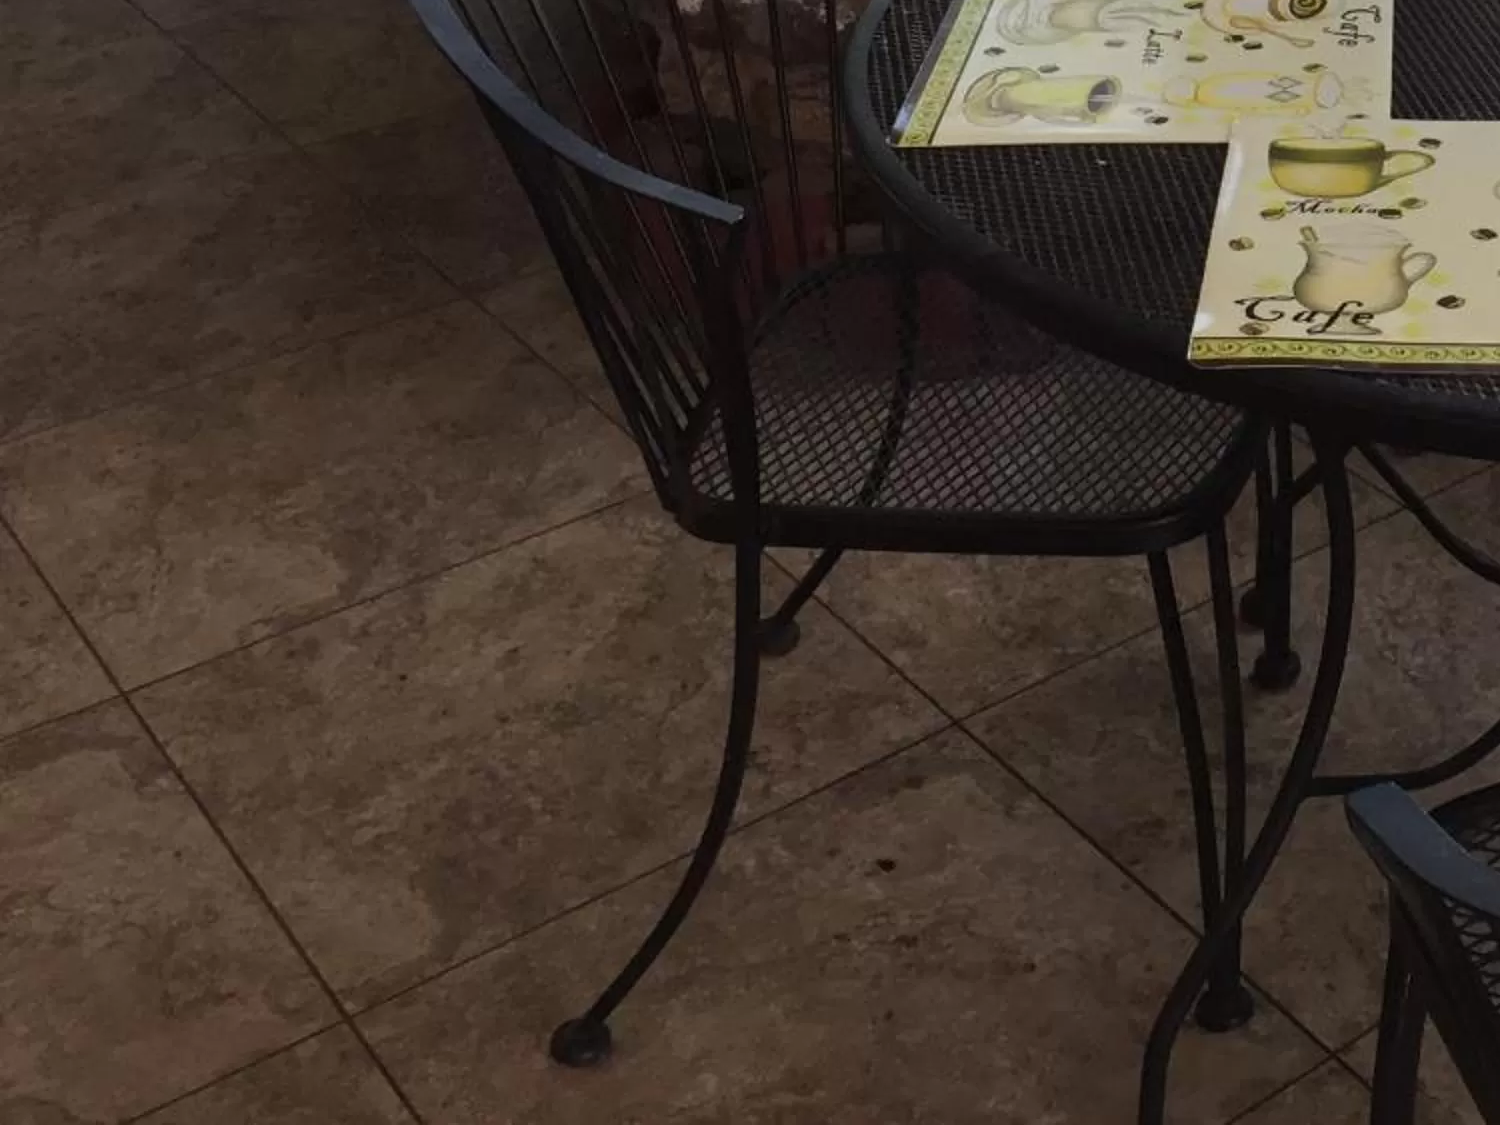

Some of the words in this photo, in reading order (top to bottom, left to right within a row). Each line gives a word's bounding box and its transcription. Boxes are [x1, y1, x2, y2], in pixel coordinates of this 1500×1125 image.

[1322, 4, 1382, 47] Cafe
[1284, 197, 1378, 214] Mocha
[1234, 295, 1375, 335] Cafe
